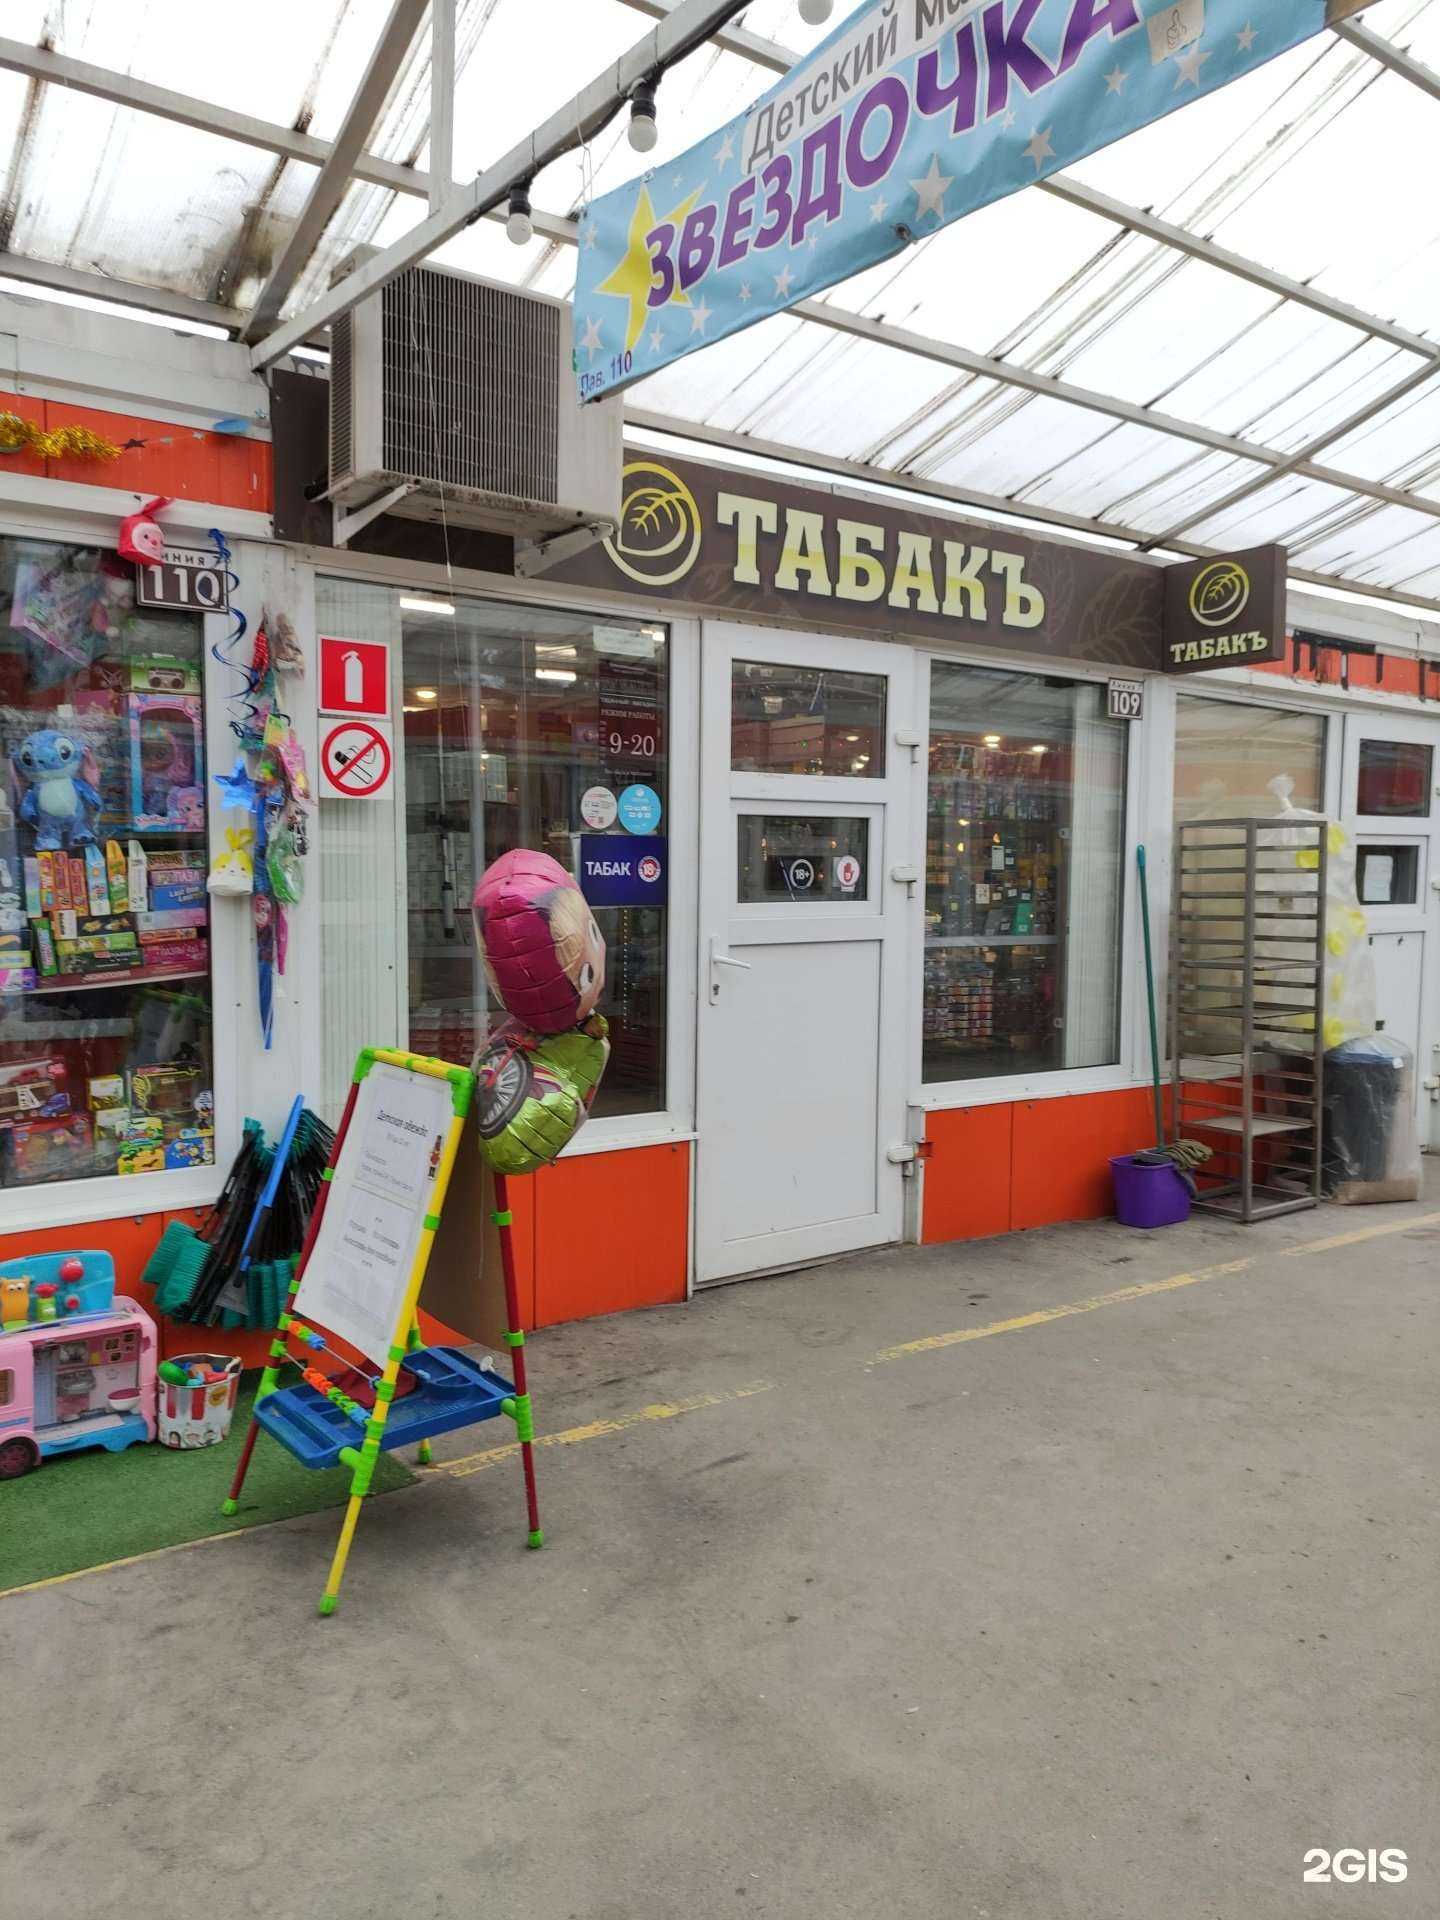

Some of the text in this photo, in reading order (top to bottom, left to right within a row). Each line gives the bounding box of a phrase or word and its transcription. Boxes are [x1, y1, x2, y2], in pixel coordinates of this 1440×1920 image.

[748, 0, 898, 174] Детский
[645, 0, 1140, 307] ЗВЕЗДОЧКА
[610, 350, 632, 380] 110
[716, 492, 1046, 629] ТАБАКЪ
[148, 564, 220, 606] 110
[1169, 629, 1268, 664] ТАБАКЪ
[1112, 691, 1140, 715] 109
[609, 732, 655, 756] 9-20
[584, 861, 631, 876] ТАБАК
[795, 868, 810, 880] 18+
